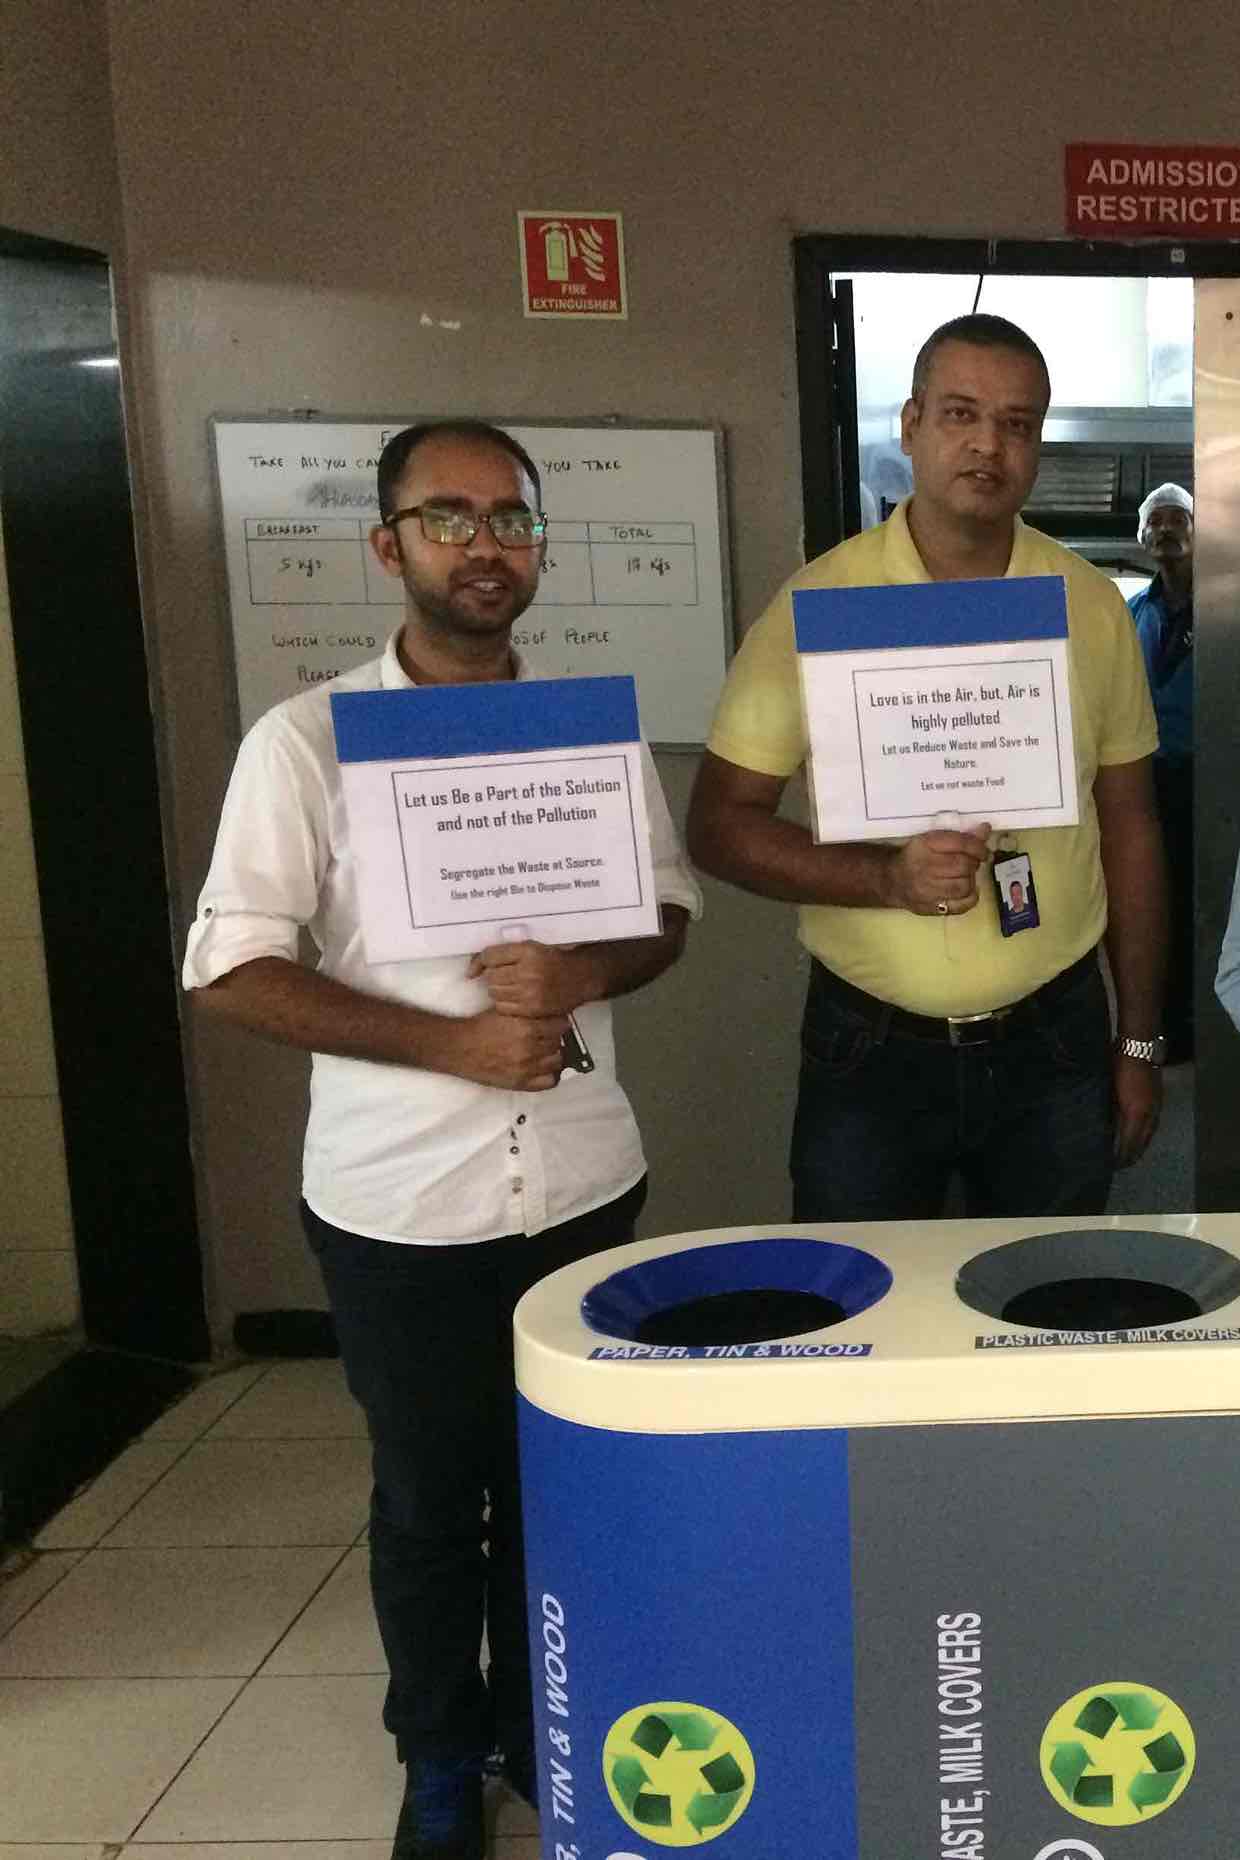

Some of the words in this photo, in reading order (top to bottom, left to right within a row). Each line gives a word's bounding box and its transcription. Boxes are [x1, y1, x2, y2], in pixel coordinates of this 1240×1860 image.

[559, 283, 587, 295] FIRE
[532, 298, 618, 310] EXTINGUISHER
[542, 460, 570, 472] YOU
[610, 526, 655, 539] TOTAL
[272, 633, 318, 648] WHICH
[326, 634, 376, 648] COULD
[564, 628, 609, 645] PEOPLE
[870, 692, 898, 708] Love
[902, 690, 913, 705] is
[917, 689, 928, 705] in
[931, 689, 951, 703] the
[954, 687, 977, 703] Air,
[980, 685, 1003, 701] but,
[1007, 684, 1026, 699] Air
[1029, 683, 1040, 698] is
[911, 714, 948, 732] highly
[952, 711, 1000, 729] polluted
[882, 743, 897, 756] Let
[899, 744, 911, 755] us
[913, 742, 946, 753] Reduce
[949, 740, 978, 751] Waste
[980, 737, 997, 749] and
[999, 737, 1022, 748] Save
[1024, 735, 1040, 746] the
[404, 791, 426, 808] Let
[431, 793, 448, 807] us
[451, 788, 470, 805] Be
[474, 791, 483, 802] a
[486, 785, 518, 801] Part
[522, 782, 535, 799] of
[539, 782, 561, 798] the
[566, 778, 621, 796] Solution
[921, 781, 934, 791] Let
[437, 817, 461, 832] and
[467, 814, 489, 830] not
[493, 811, 506, 827] of
[511, 809, 533, 825] the
[537, 806, 597, 824] Pollution
[440, 866, 495, 881] Segregate
[498, 863, 515, 875] the
[517, 861, 550, 874] Waste
[553, 860, 563, 871] at
[470, 887, 484, 898] the
[487, 885, 508, 898] right
[983, 1333, 1054, 1347] PLASTIC
[1058, 1331, 1123, 1345] WASTE,
[1126, 1330, 1169, 1343] MILK
[1172, 1328, 1240, 1341] COVERS
[703, 1345, 746, 1358] TIN
[753, 1345, 771, 1357] &
[781, 1344, 865, 1357] WOOD
[542, 1593, 570, 1717] WOOD
[936, 1612, 983, 1716] COVERS
[549, 1727, 572, 1757] &
[939, 1722, 985, 1784] MILK
[551, 1765, 576, 1825] TIN
[940, 1789, 992, 1860] ASTE,
